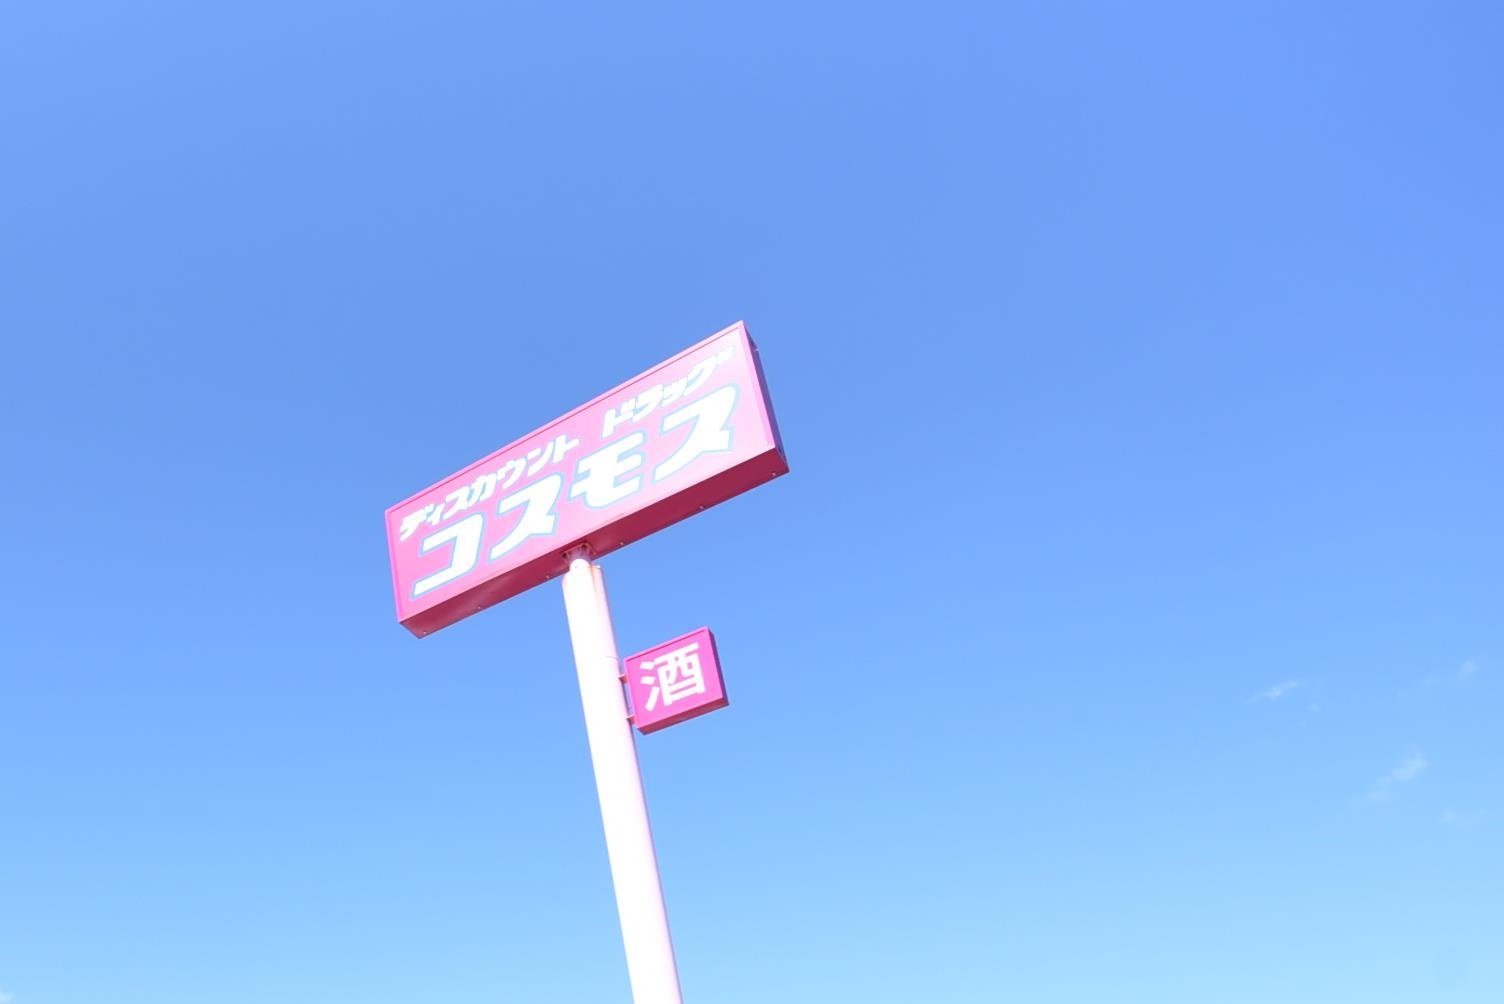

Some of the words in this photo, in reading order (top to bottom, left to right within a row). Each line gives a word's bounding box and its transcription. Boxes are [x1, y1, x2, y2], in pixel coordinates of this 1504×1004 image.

[400, 433, 579, 541] ディスカウント
[603, 347, 735, 438] ドラッグ
[412, 385, 738, 599] コスモス
[640, 642, 704, 712] 酒
